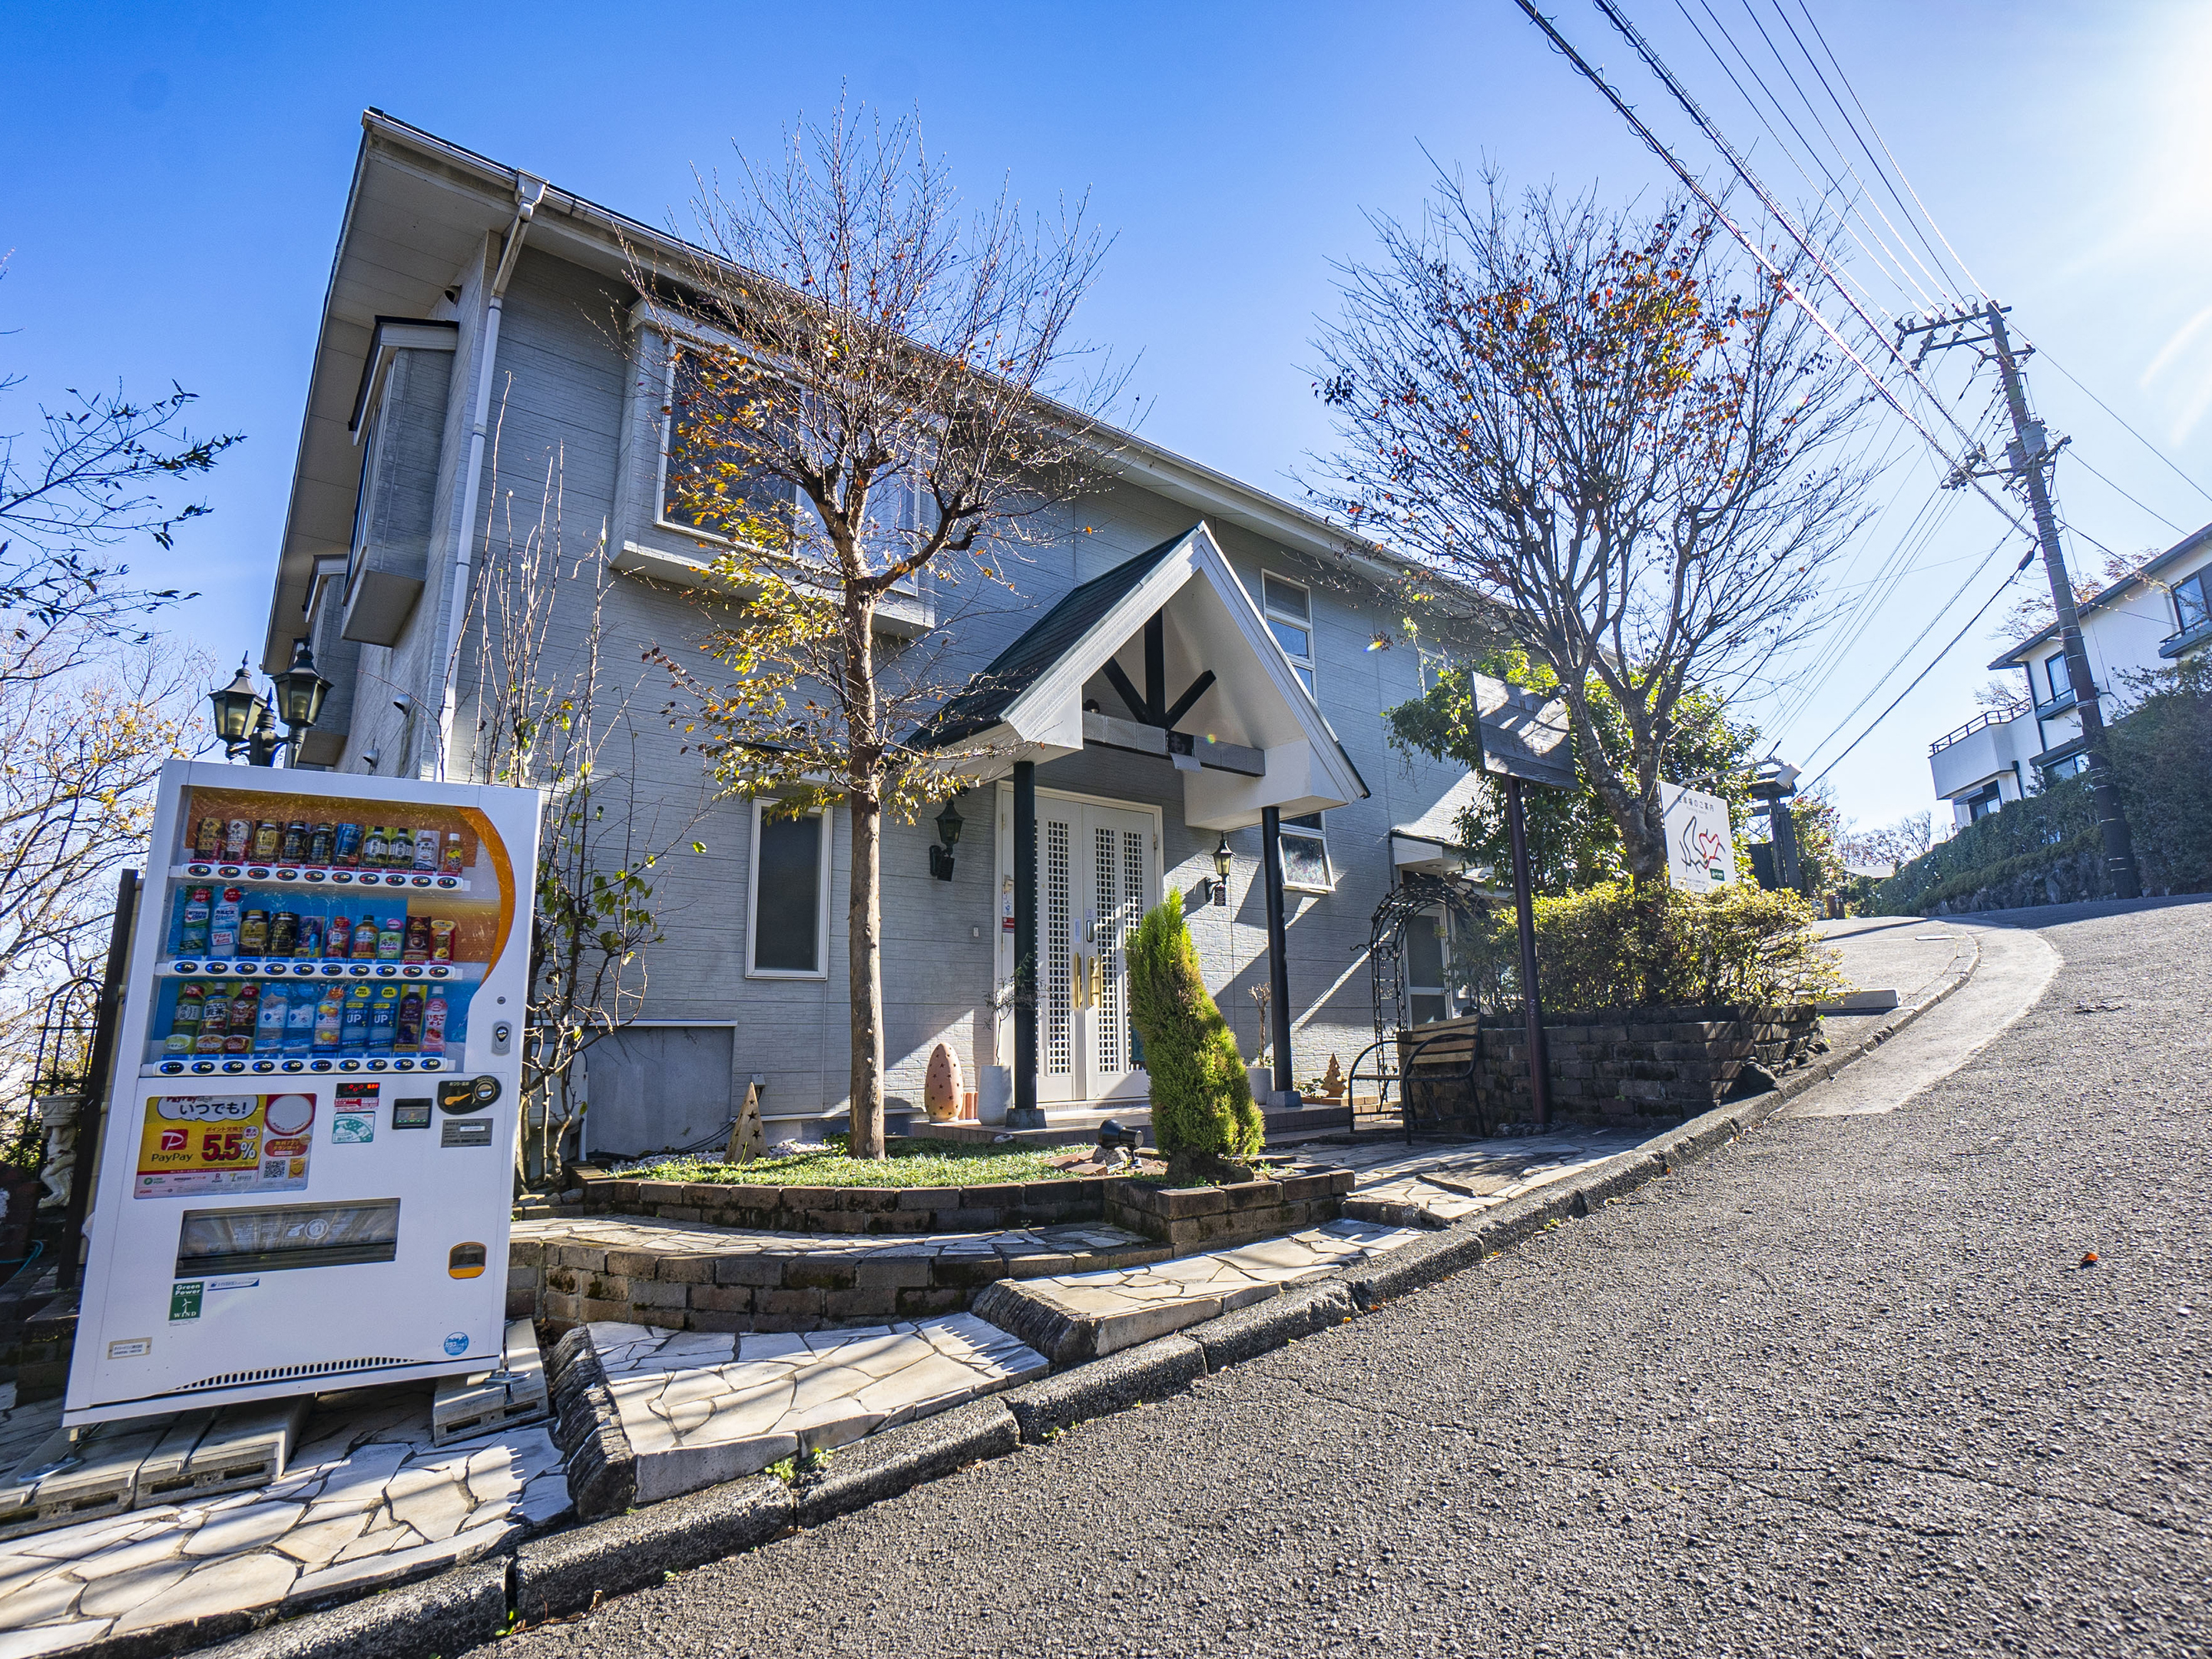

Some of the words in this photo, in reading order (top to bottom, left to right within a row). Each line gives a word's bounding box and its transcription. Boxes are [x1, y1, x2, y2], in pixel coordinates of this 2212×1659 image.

[346, 1014, 362, 1023] UP
[373, 1014, 388, 1023] UP
[180, 1102, 247, 1114] いつでも!
[151, 1152, 194, 1163] PayPay
[173, 1310, 197, 1319] WIND
